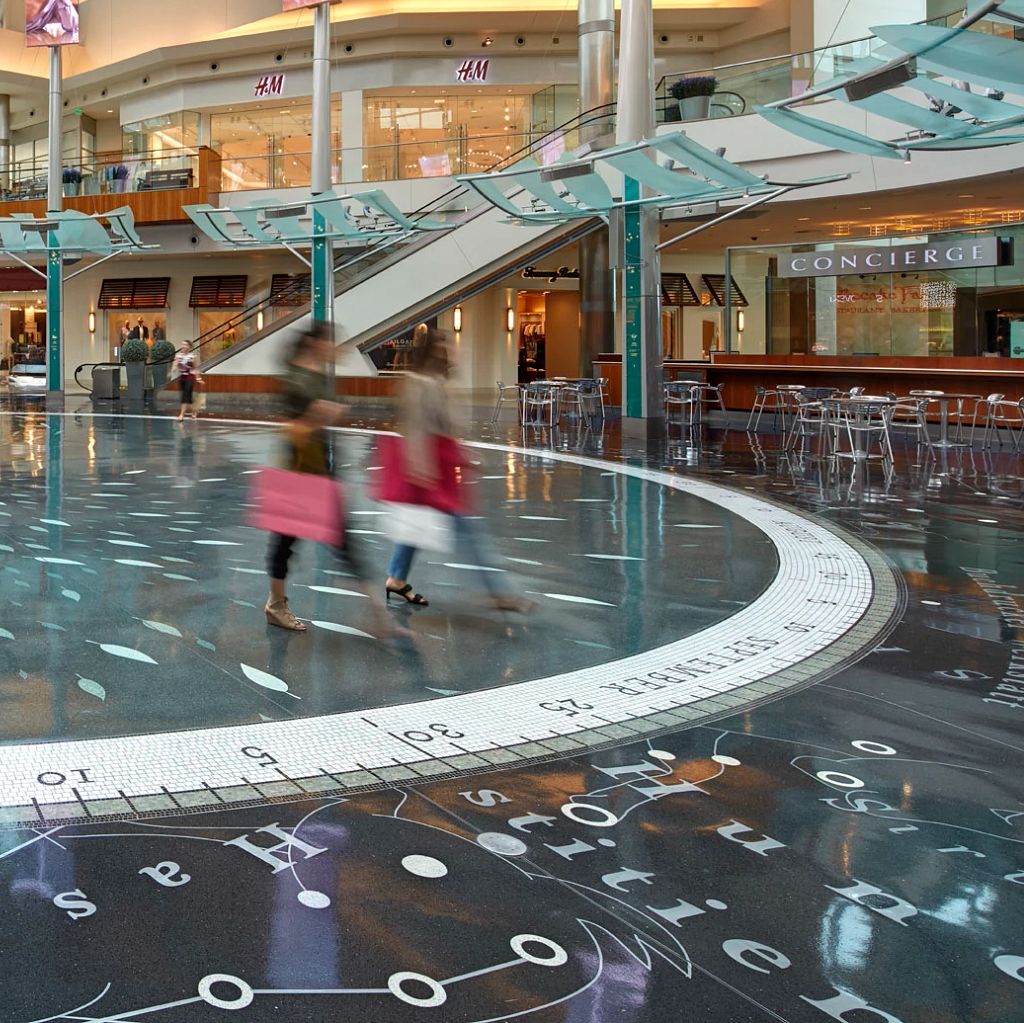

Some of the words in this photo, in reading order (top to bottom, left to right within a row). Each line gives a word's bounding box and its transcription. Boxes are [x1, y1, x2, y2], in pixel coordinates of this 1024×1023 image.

[791, 245, 983, 272] CONCIERGE
[599, 634, 780, 697] SEPTEMBER
[538, 698, 594, 718] 25
[403, 722, 465, 742] 30
[240, 745, 278, 768] 5
[37, 768, 92, 787] 10
